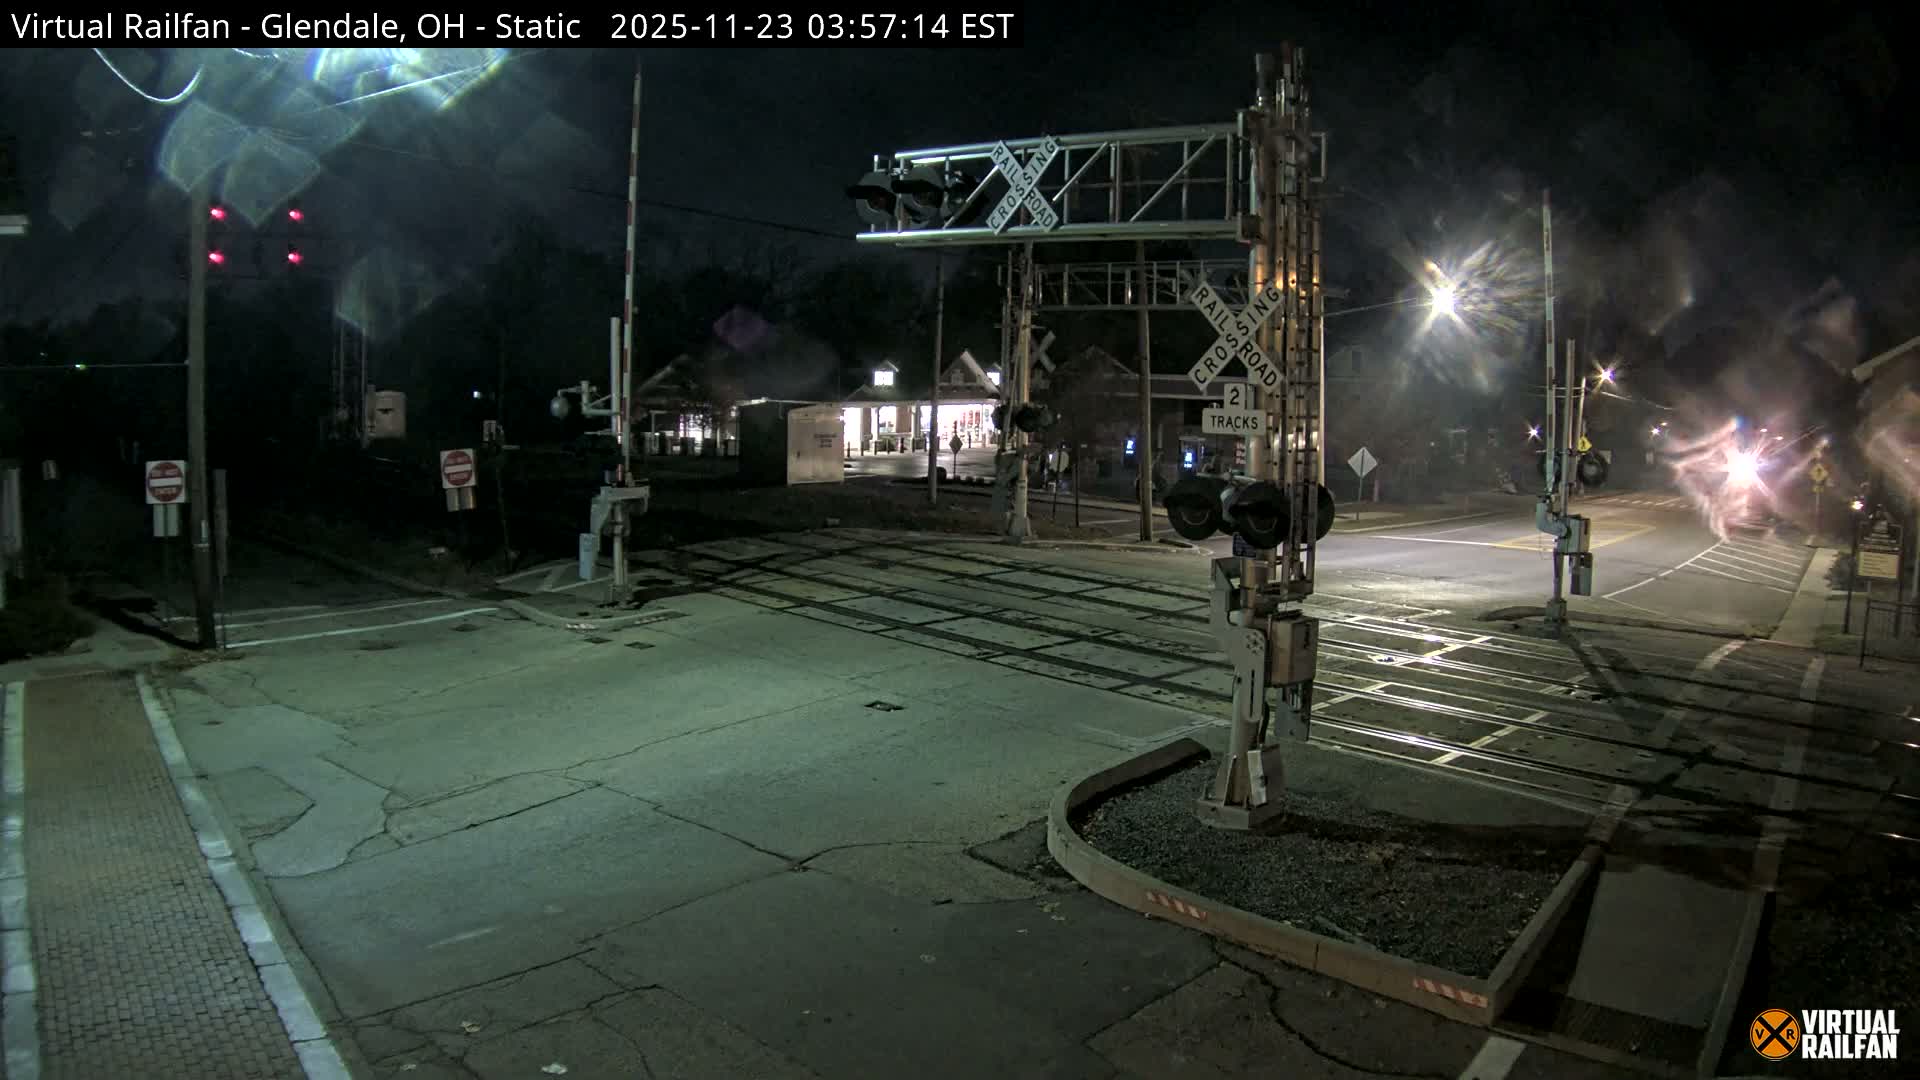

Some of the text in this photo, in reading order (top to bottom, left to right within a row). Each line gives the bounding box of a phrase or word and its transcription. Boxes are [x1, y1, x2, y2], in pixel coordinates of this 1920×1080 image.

[990, 140, 1055, 230] CROSSING
[992, 145, 1053, 228] RAILROAD
[1193, 286, 1278, 388] RAILROAD
[1194, 286, 1280, 385] CROSSING
[1210, 415, 1258, 431] TRACKS
[1229, 387, 1240, 406] 2
